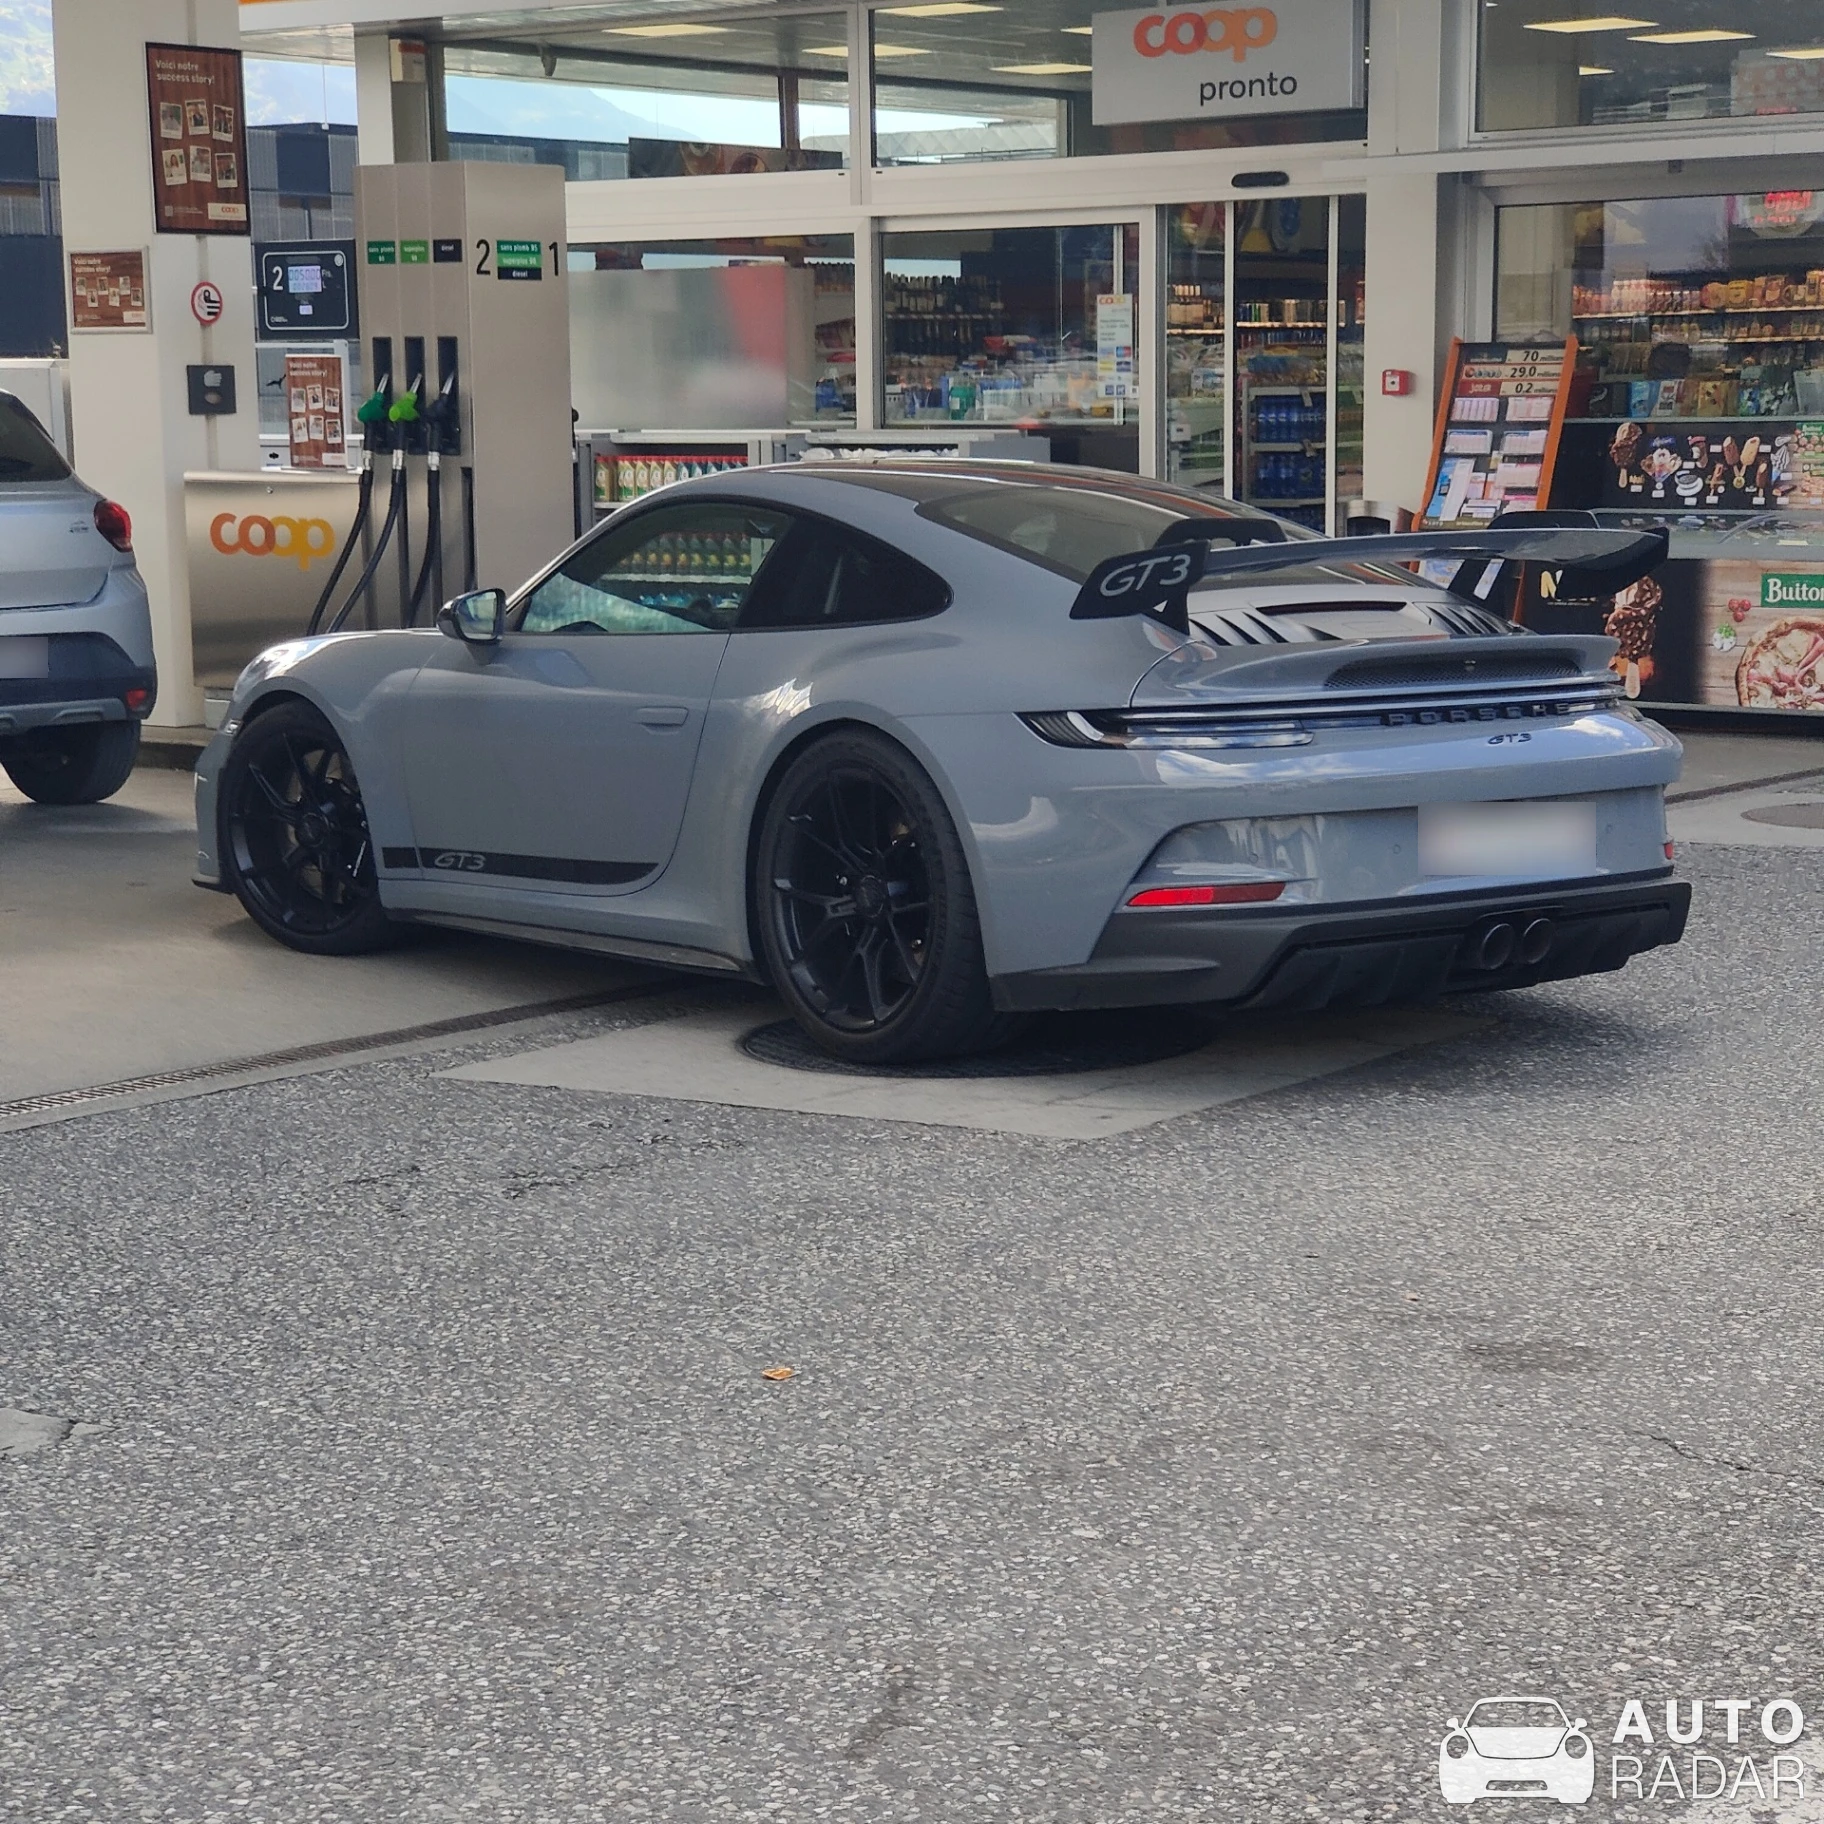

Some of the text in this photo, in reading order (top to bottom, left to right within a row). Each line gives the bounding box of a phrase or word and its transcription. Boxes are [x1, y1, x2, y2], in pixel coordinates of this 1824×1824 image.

[1133, 7, 1278, 63] coop
[155, 60, 199, 72] Voici notre
[156, 73, 215, 86] success story!
[1200, 72, 1298, 106] pronto
[476, 239, 491, 275] 2
[514, 244, 530, 252] plomb
[548, 241, 559, 276] 1
[272, 266, 284, 290] 2
[512, 270, 528, 278] diesel
[1523, 350, 1539, 362] 70
[210, 513, 335, 572] coop
[1100, 554, 1191, 597] GT3
[1389, 702, 1570, 727] PORSCHE
[1487, 732, 1532, 745] GT3
[434, 851, 486, 870] GT3
